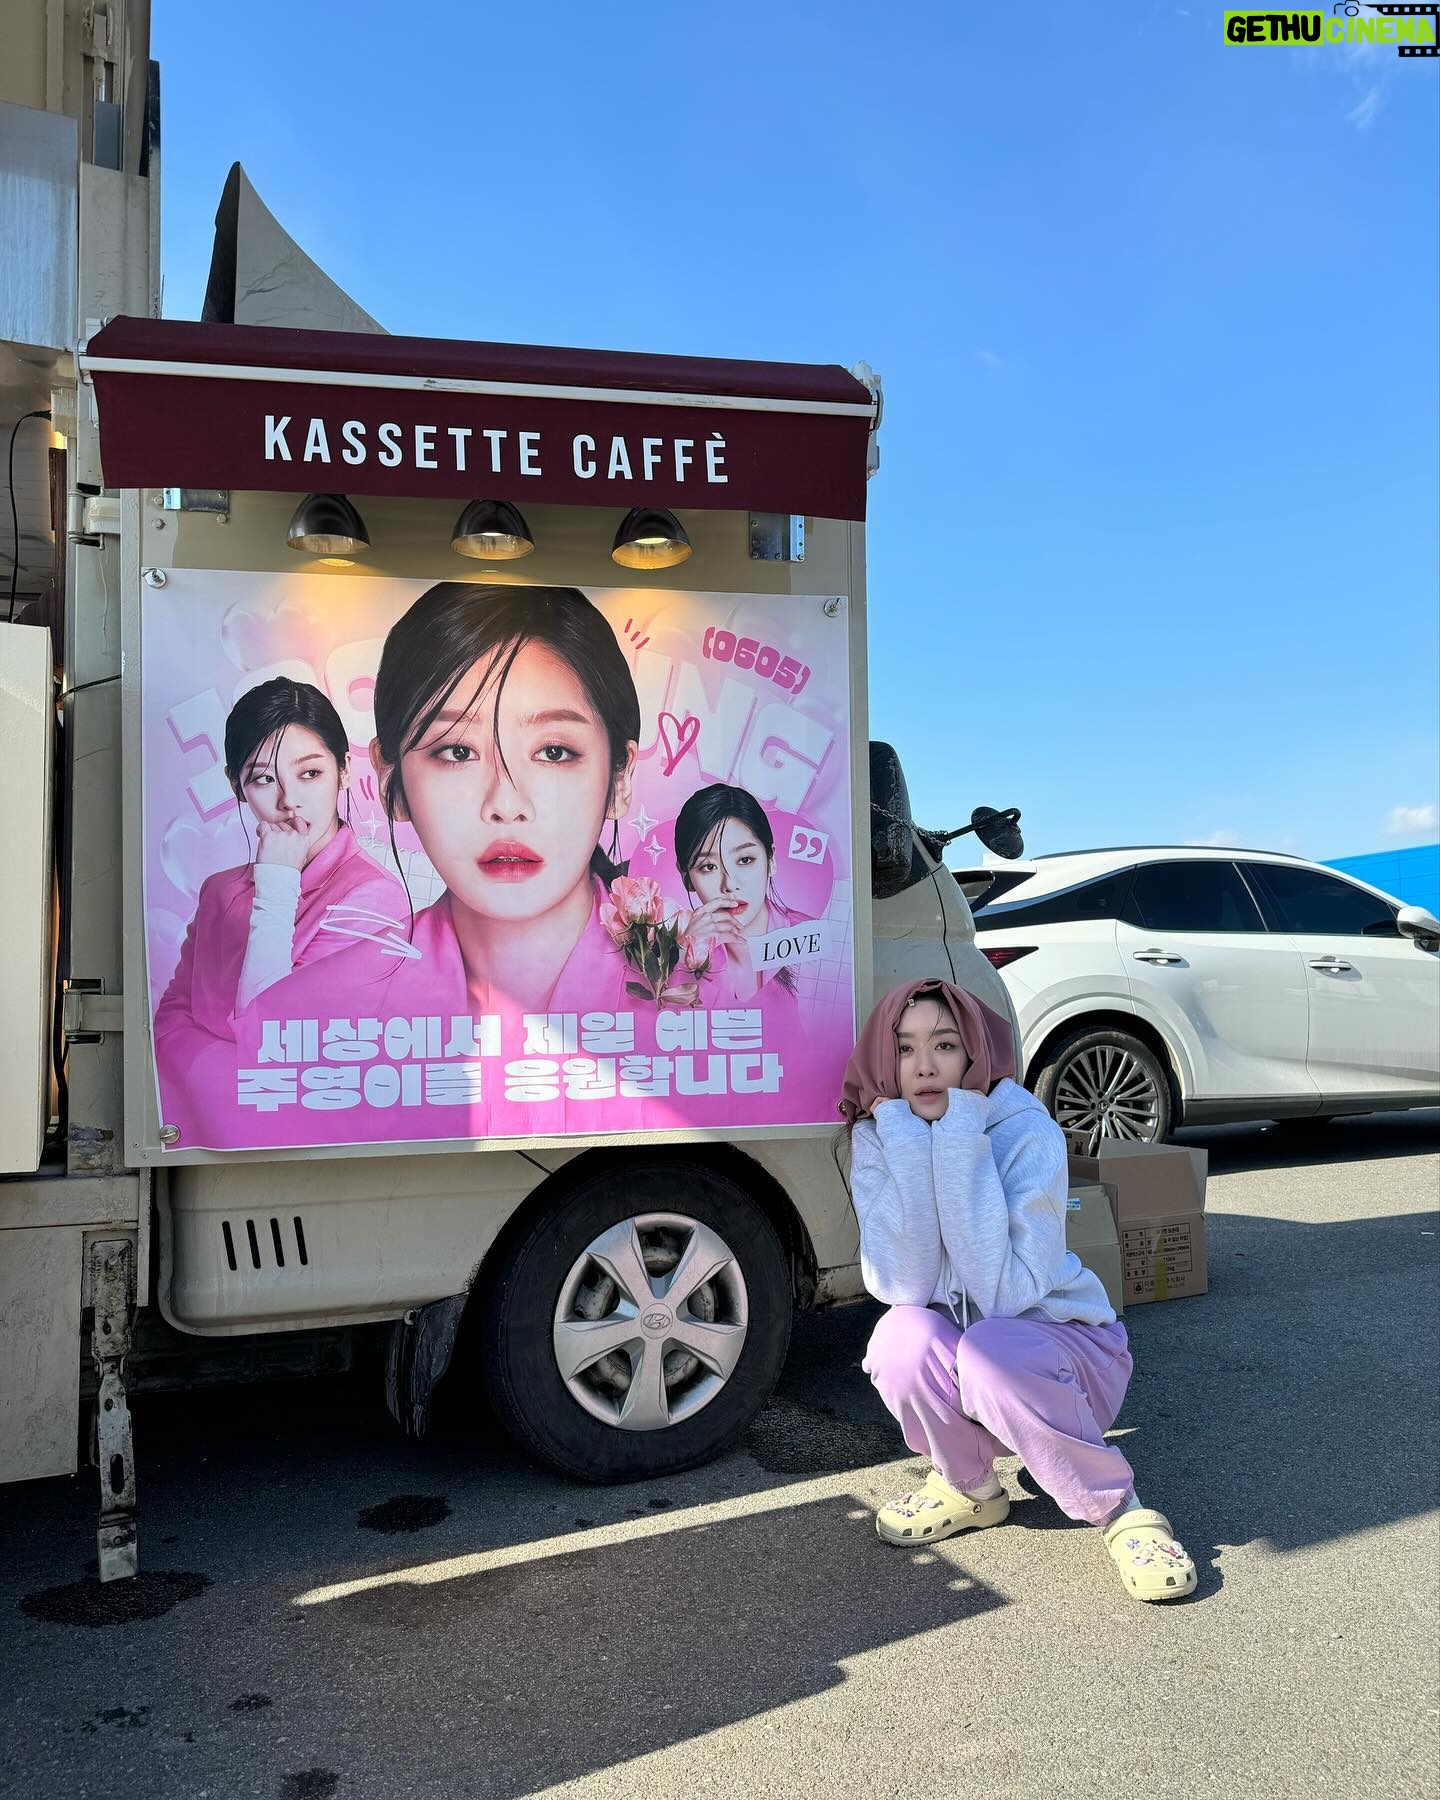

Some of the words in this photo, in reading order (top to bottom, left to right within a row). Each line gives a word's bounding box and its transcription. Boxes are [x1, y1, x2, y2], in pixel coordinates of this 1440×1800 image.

[264, 414, 542, 476] KASSETTE
[572, 432, 729, 483] CAFFÈ
[703, 626, 811, 695] (0605)
[762, 933, 821, 962] LOVE
[257, 1014, 501, 1063] 세상에서
[522, 1011, 635, 1056] 제일
[655, 1008, 763, 1052] 예쁜
[237, 1061, 482, 1112] 주영이를
[503, 1052, 784, 1103] 응원합니다
